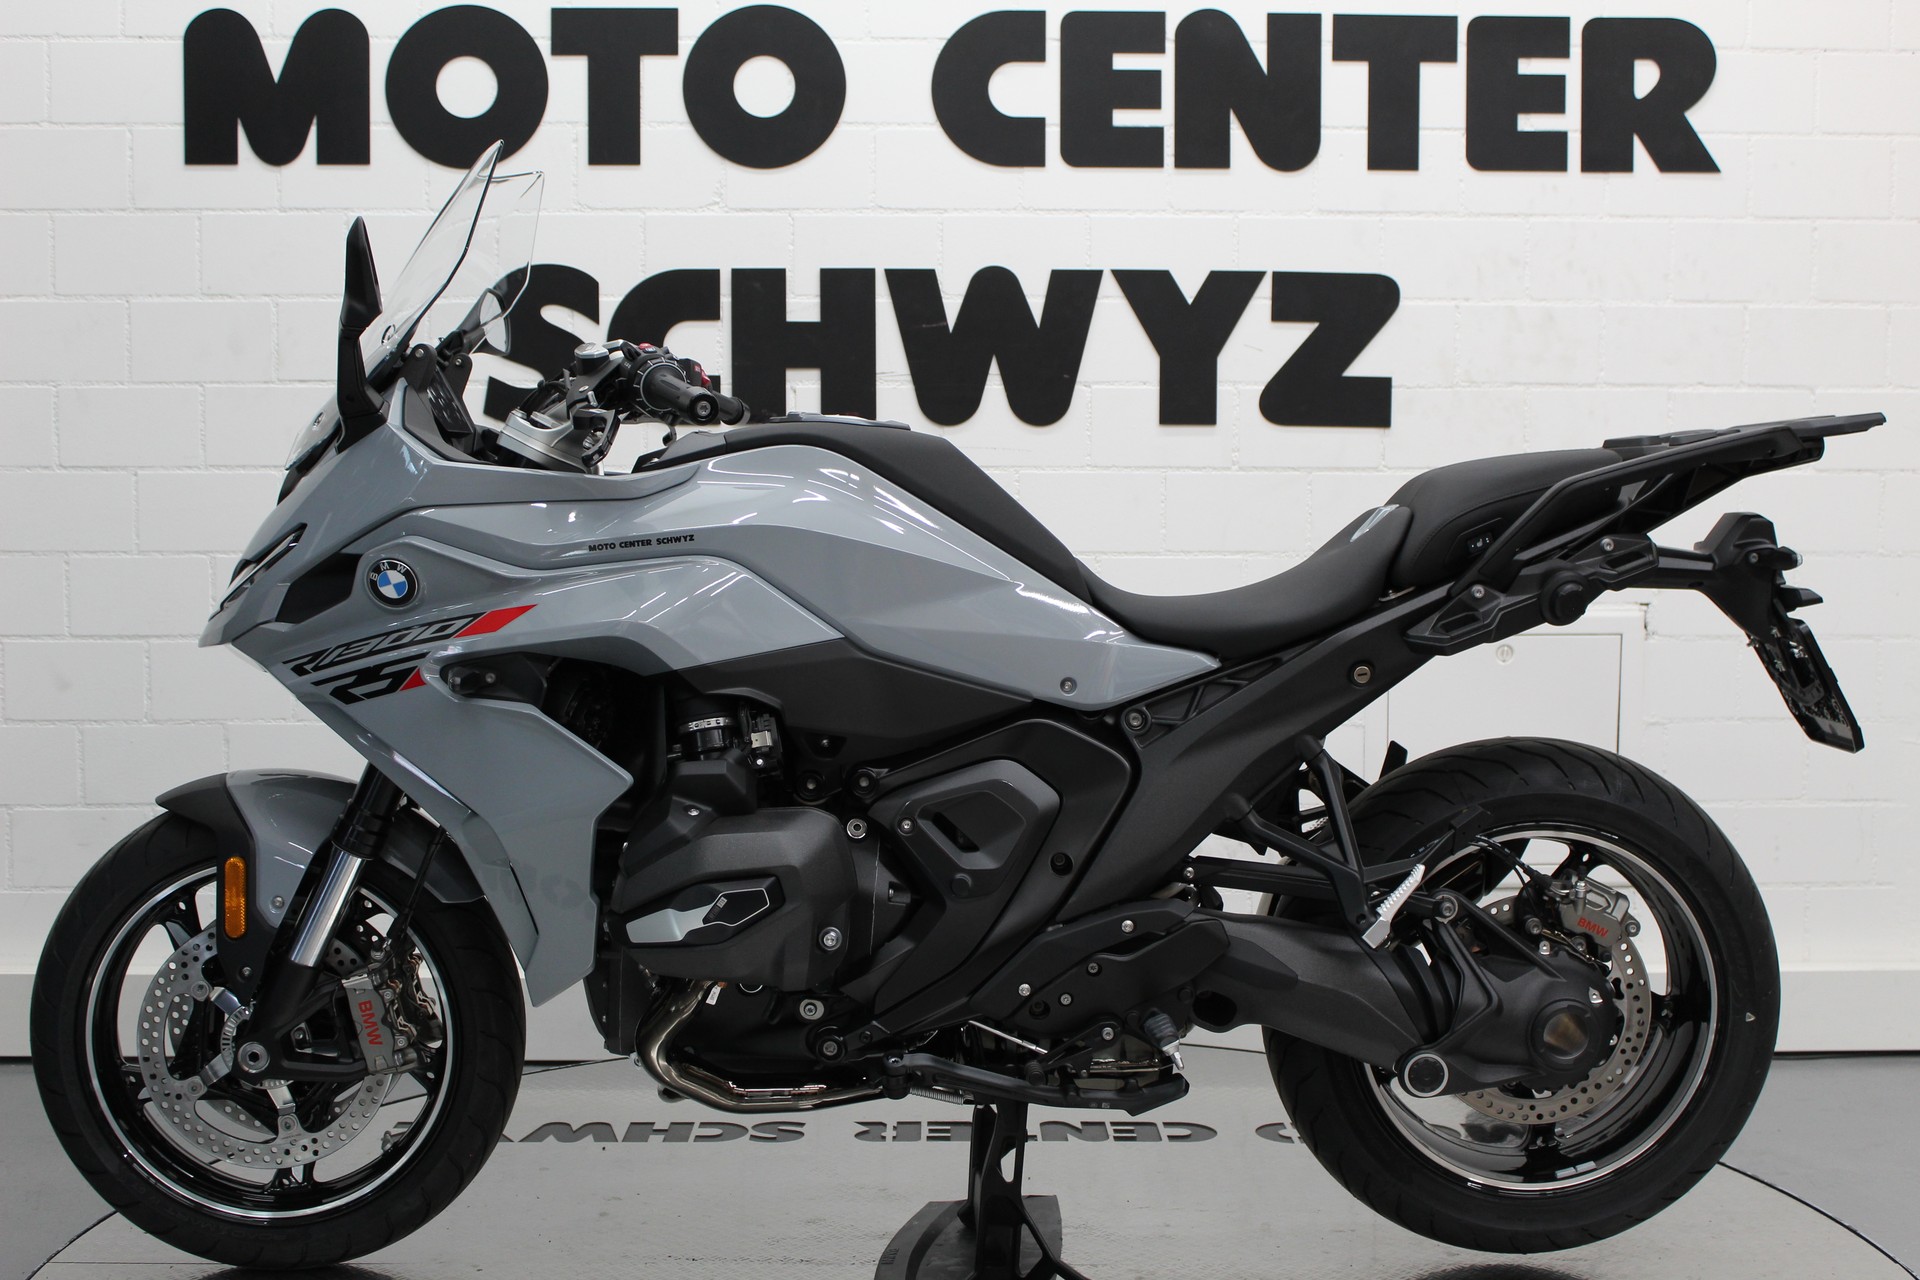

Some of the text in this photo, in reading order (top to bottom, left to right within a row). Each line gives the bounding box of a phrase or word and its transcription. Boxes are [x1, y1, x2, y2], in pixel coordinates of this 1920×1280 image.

[184, 5, 1722, 173] MOTO CENTER
[484, 263, 1400, 428] SCHWYZ
[588, 534, 695, 552] MOTO CENTER SCHWYZ
[370, 561, 407, 581] BMW
[311, 652, 432, 706] RS
[1577, 917, 1608, 938] BMW
[358, 1000, 383, 1046] BMW
[854, 1121, 1217, 1142] CENER
